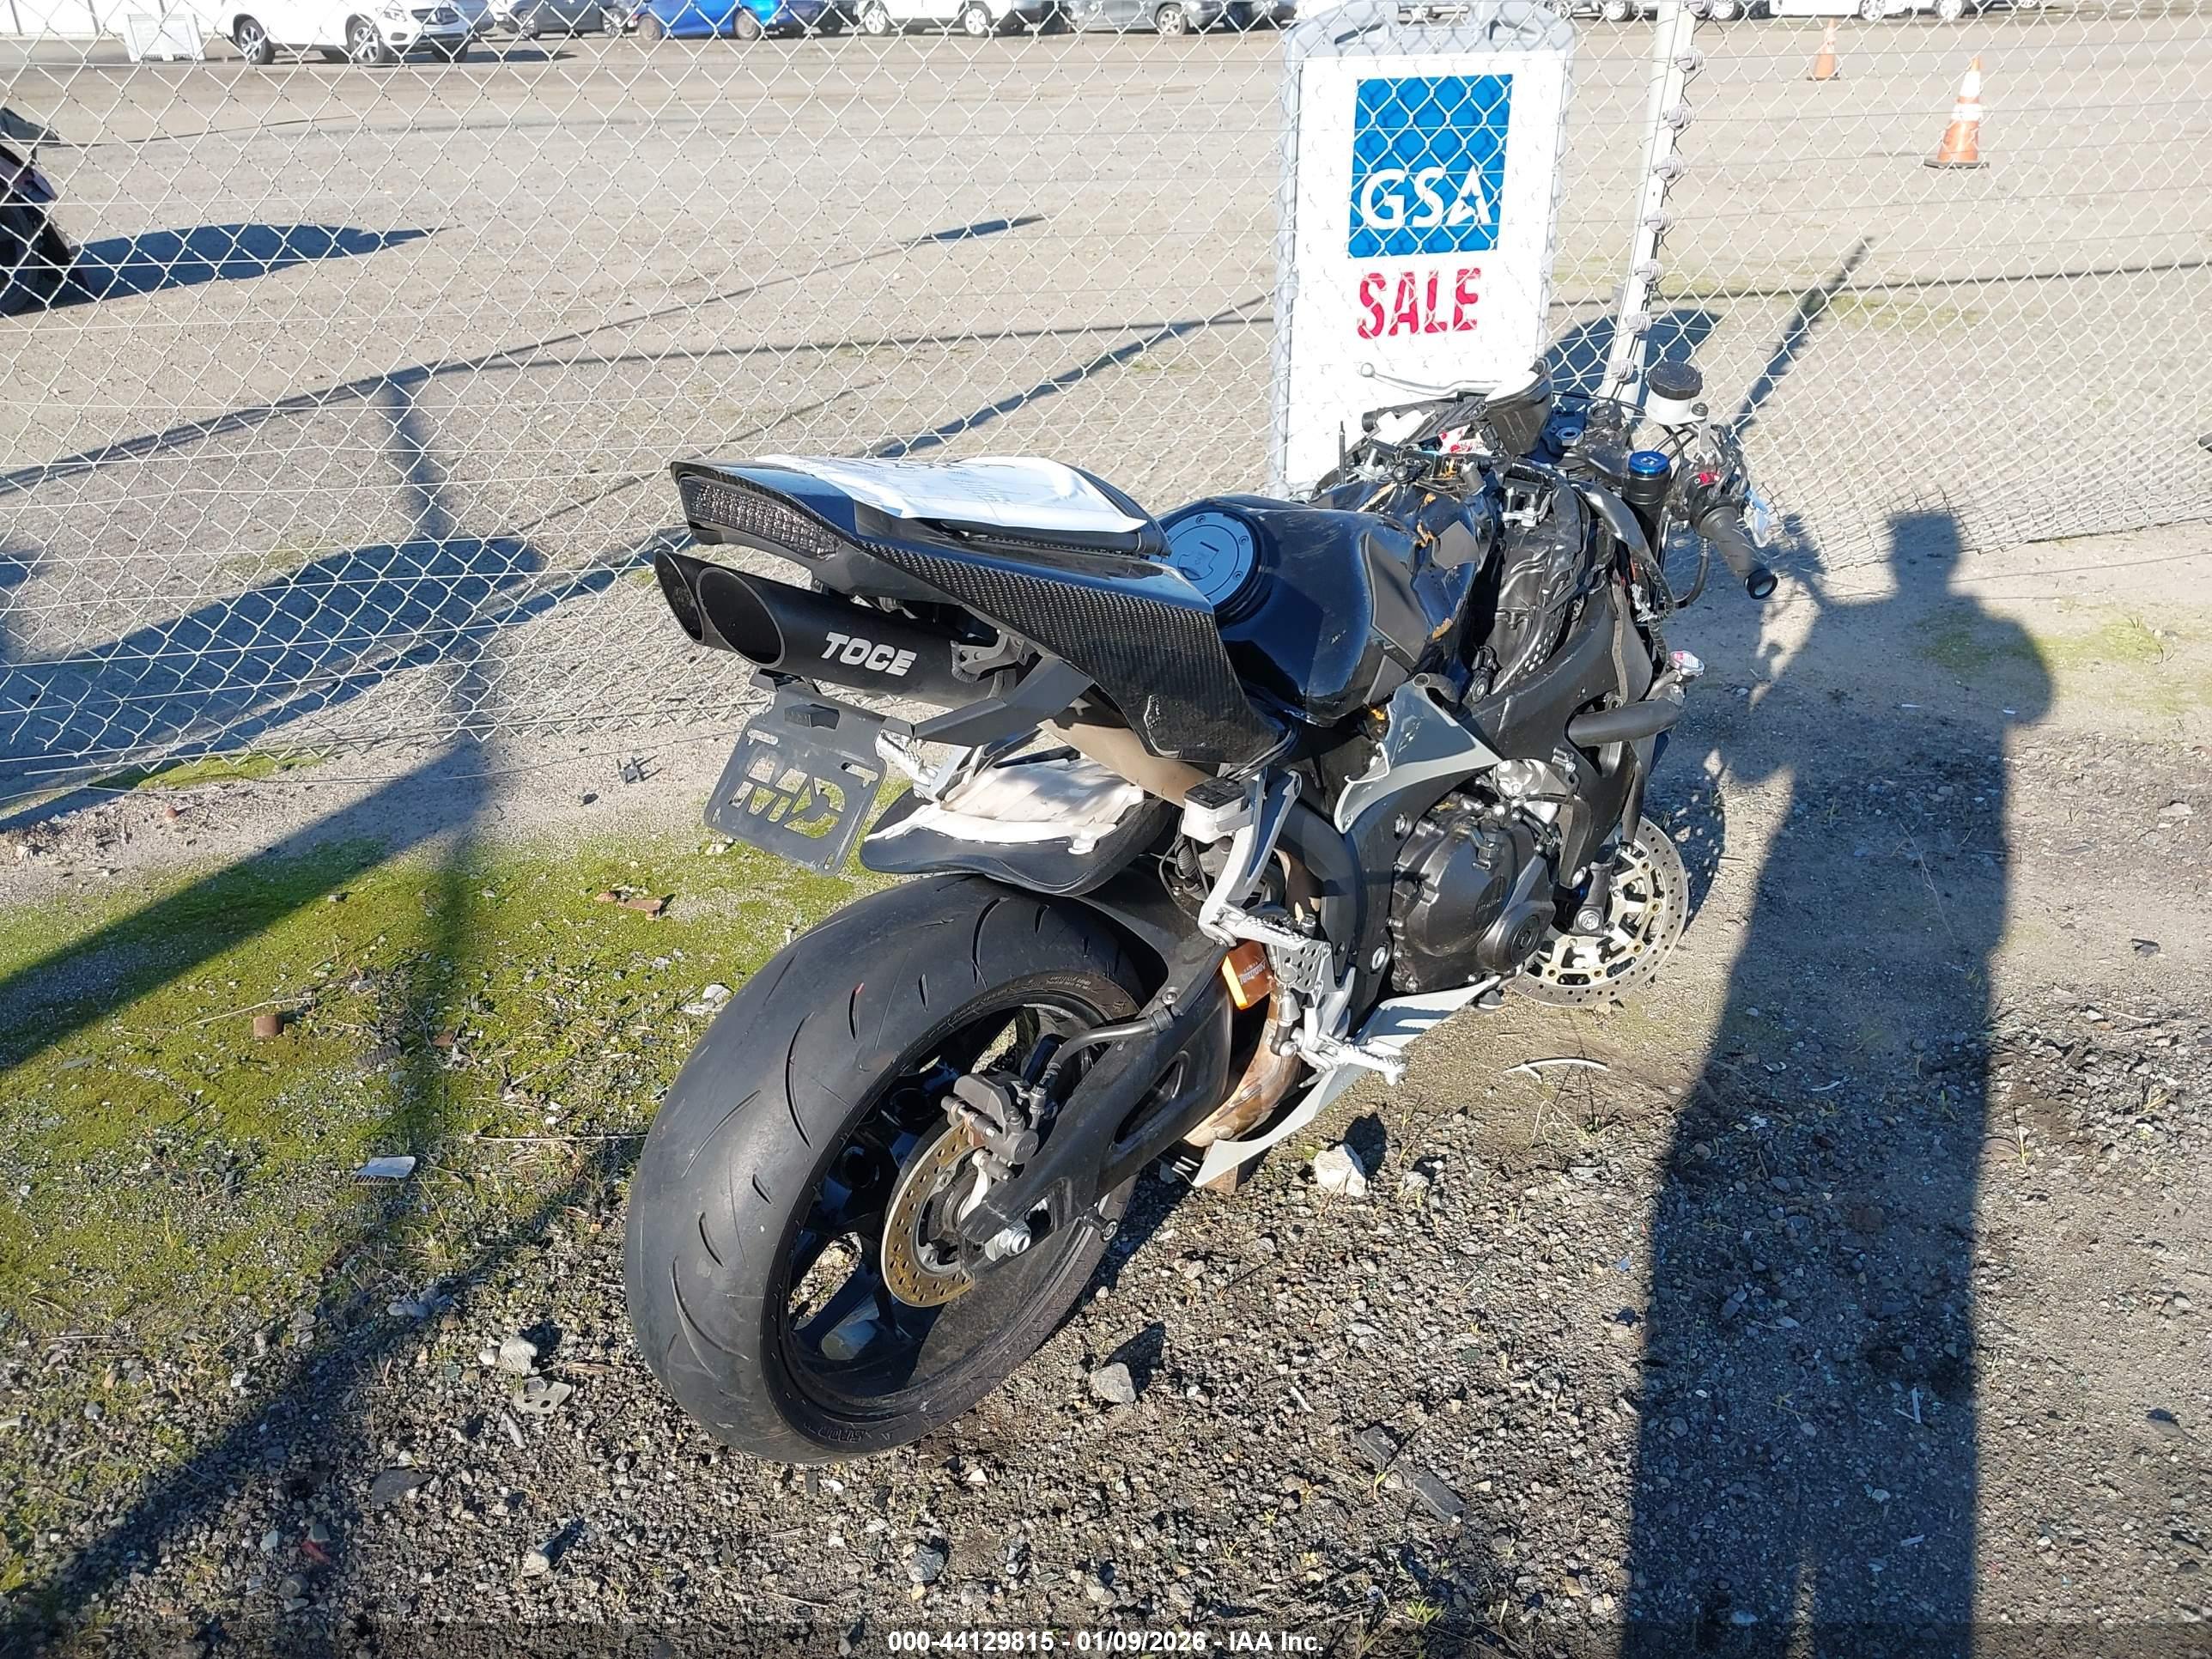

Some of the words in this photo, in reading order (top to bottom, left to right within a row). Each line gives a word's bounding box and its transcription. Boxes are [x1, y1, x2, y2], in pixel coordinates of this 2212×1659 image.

[1359, 164, 1492, 230] GSA
[1357, 267, 1482, 340] SALE
[821, 631, 918, 677] TOCE
